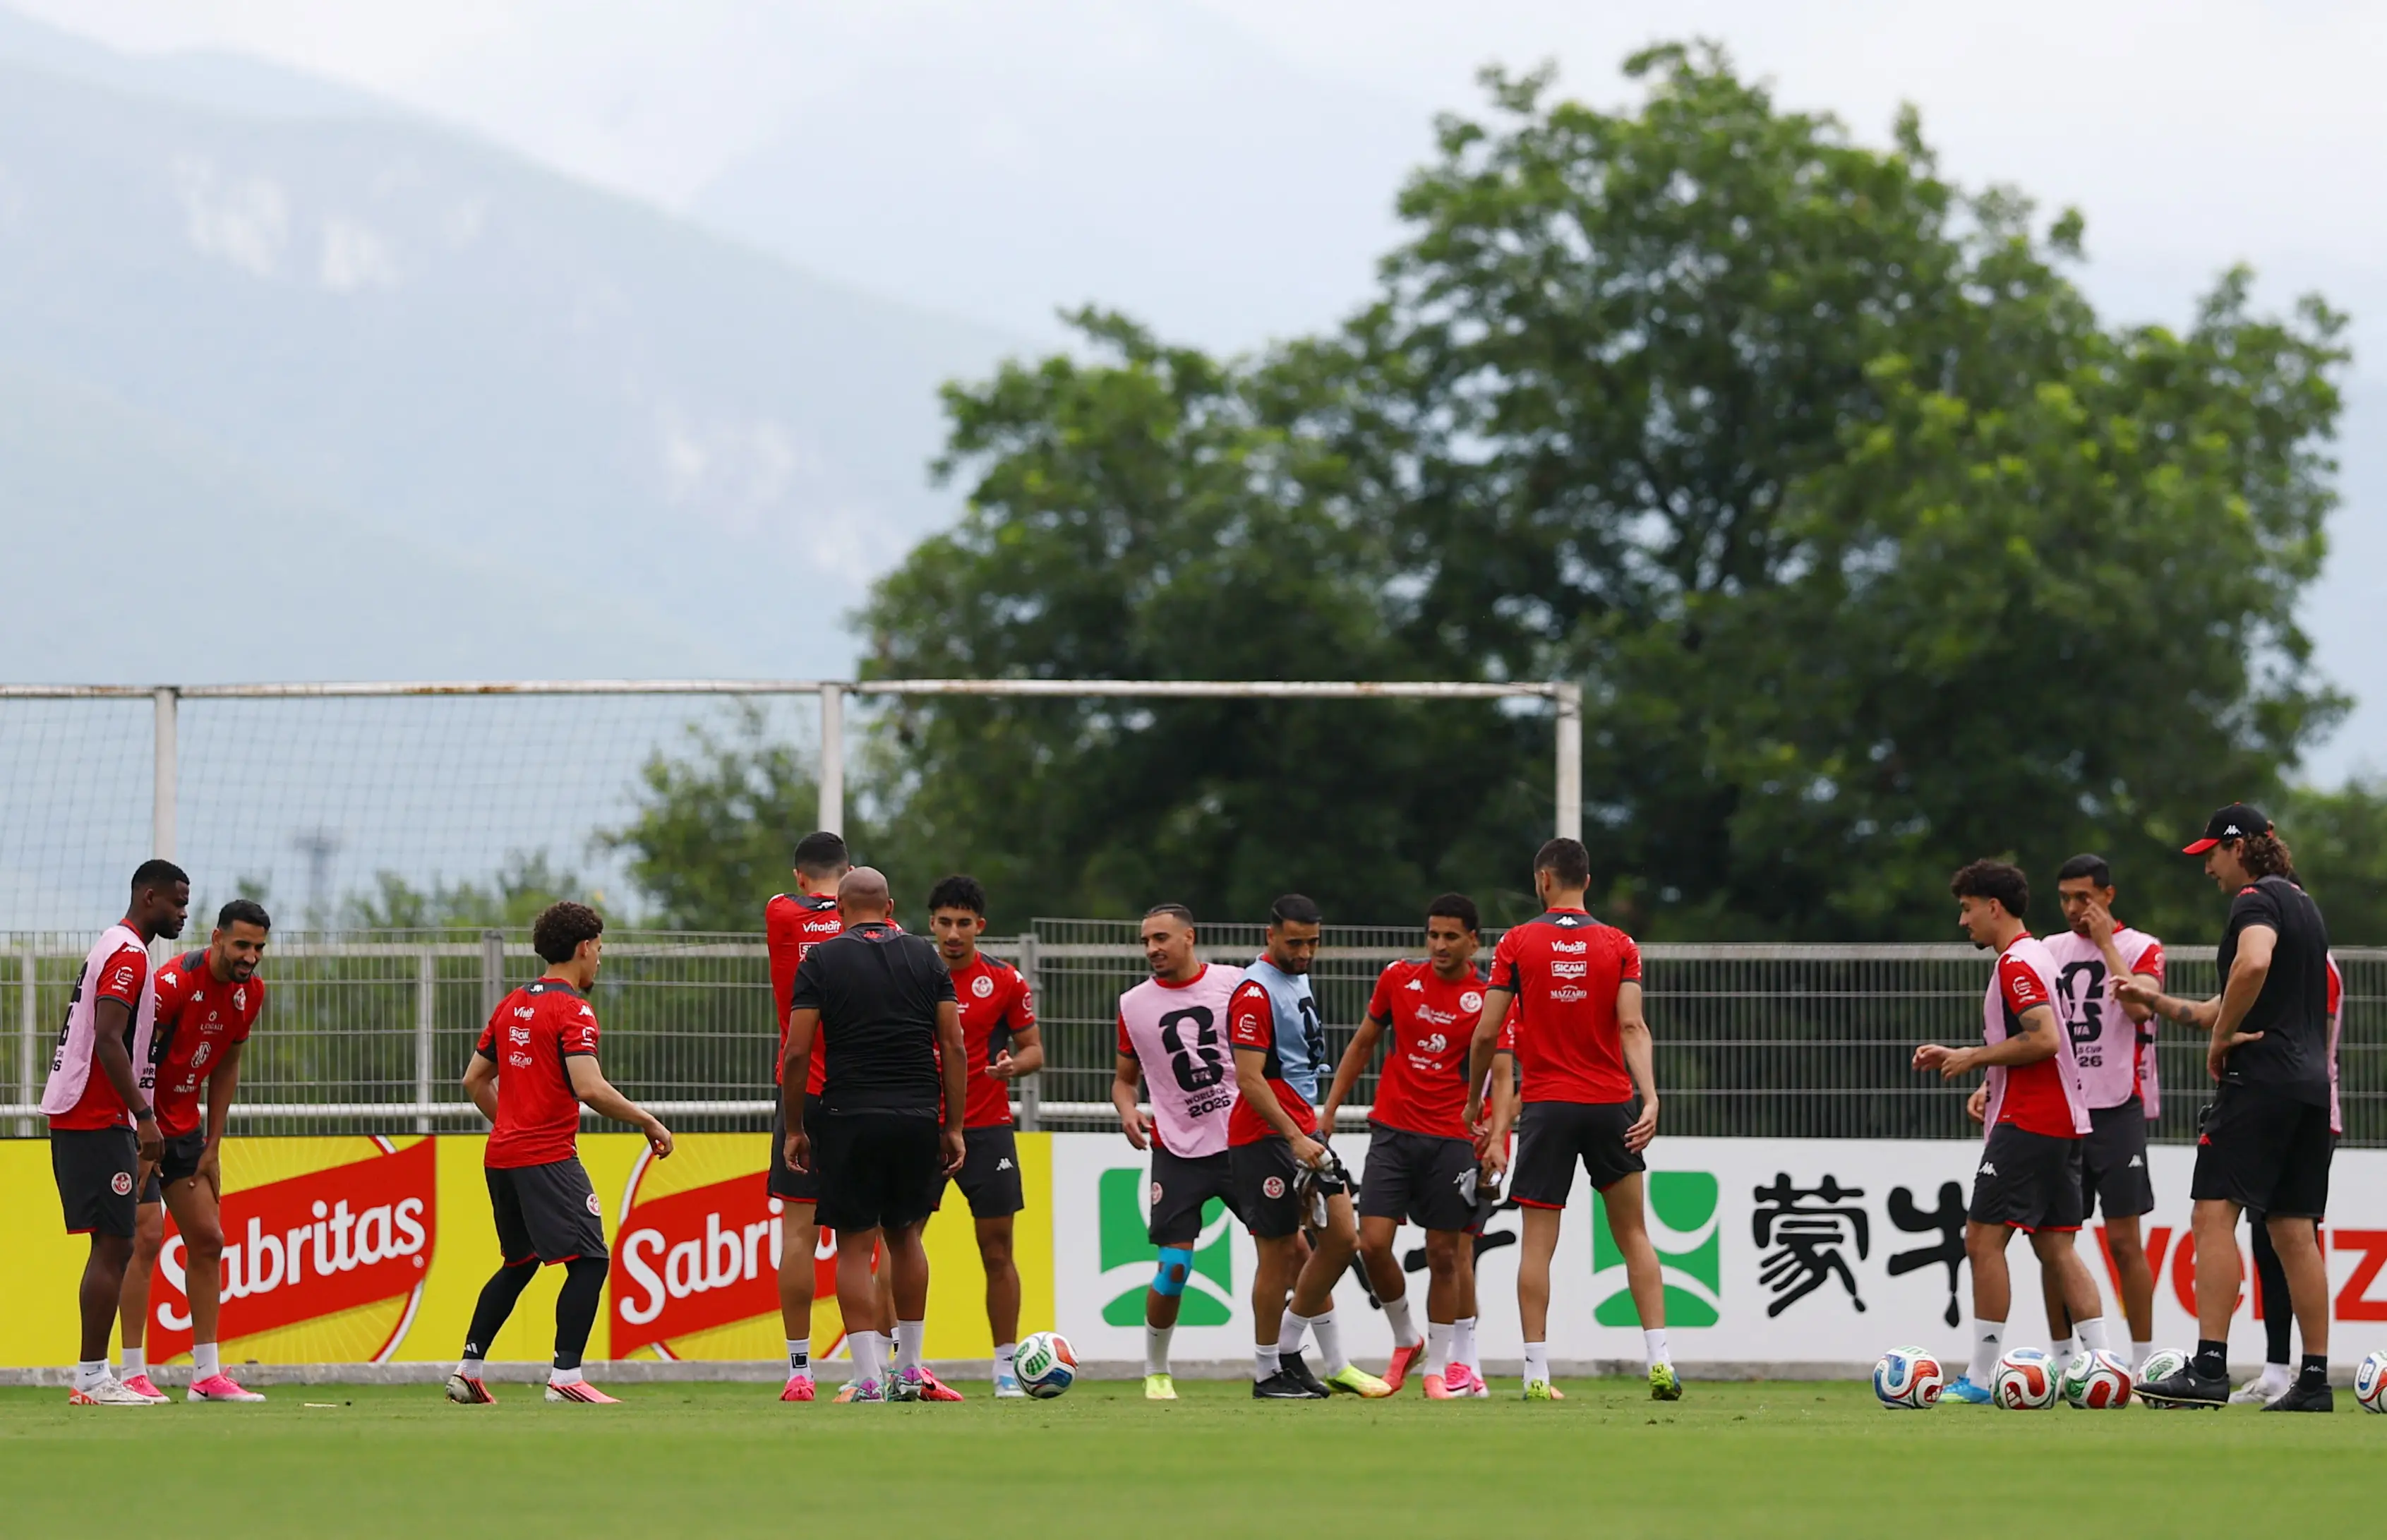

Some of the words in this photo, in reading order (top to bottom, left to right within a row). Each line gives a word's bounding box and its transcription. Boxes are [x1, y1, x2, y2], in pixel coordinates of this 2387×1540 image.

[1554, 964, 1584, 973] SICAM
[2079, 1056, 2103, 1067] 26
[1184, 1089, 1215, 1105] WORLD
[1189, 1095, 1231, 1118] 2026
[619, 1197, 838, 1325] Sabri
